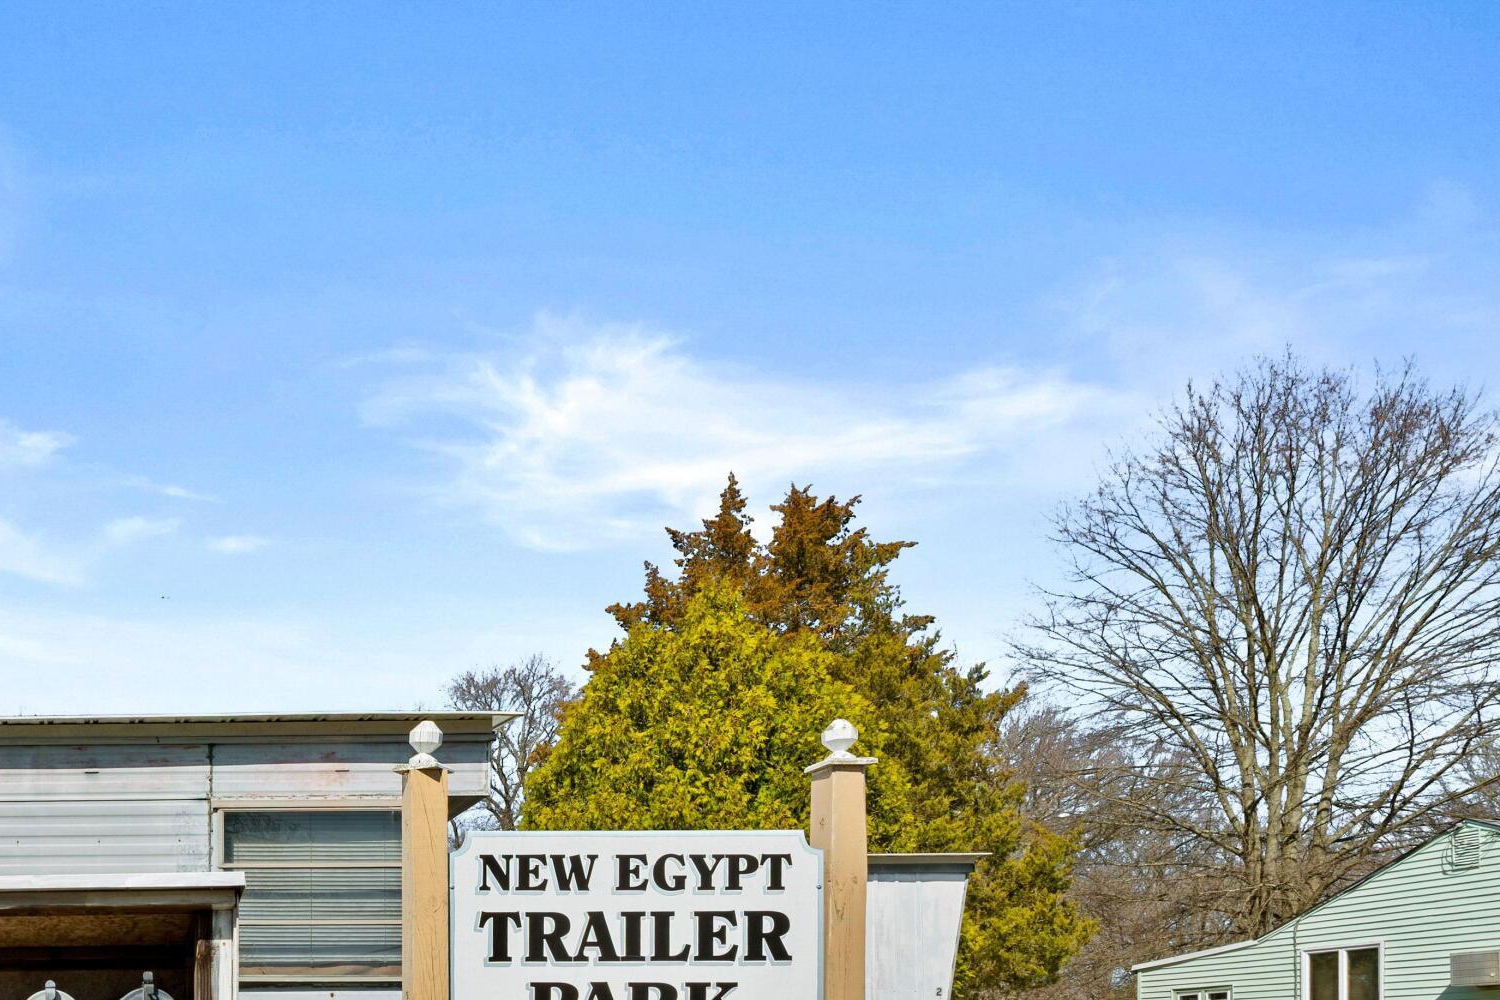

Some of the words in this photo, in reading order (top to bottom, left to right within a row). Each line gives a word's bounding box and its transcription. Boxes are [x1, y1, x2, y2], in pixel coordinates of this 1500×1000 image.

[479, 854, 598, 892] NEW
[615, 853, 793, 892] EGYPT
[479, 910, 793, 963] TRAILER
